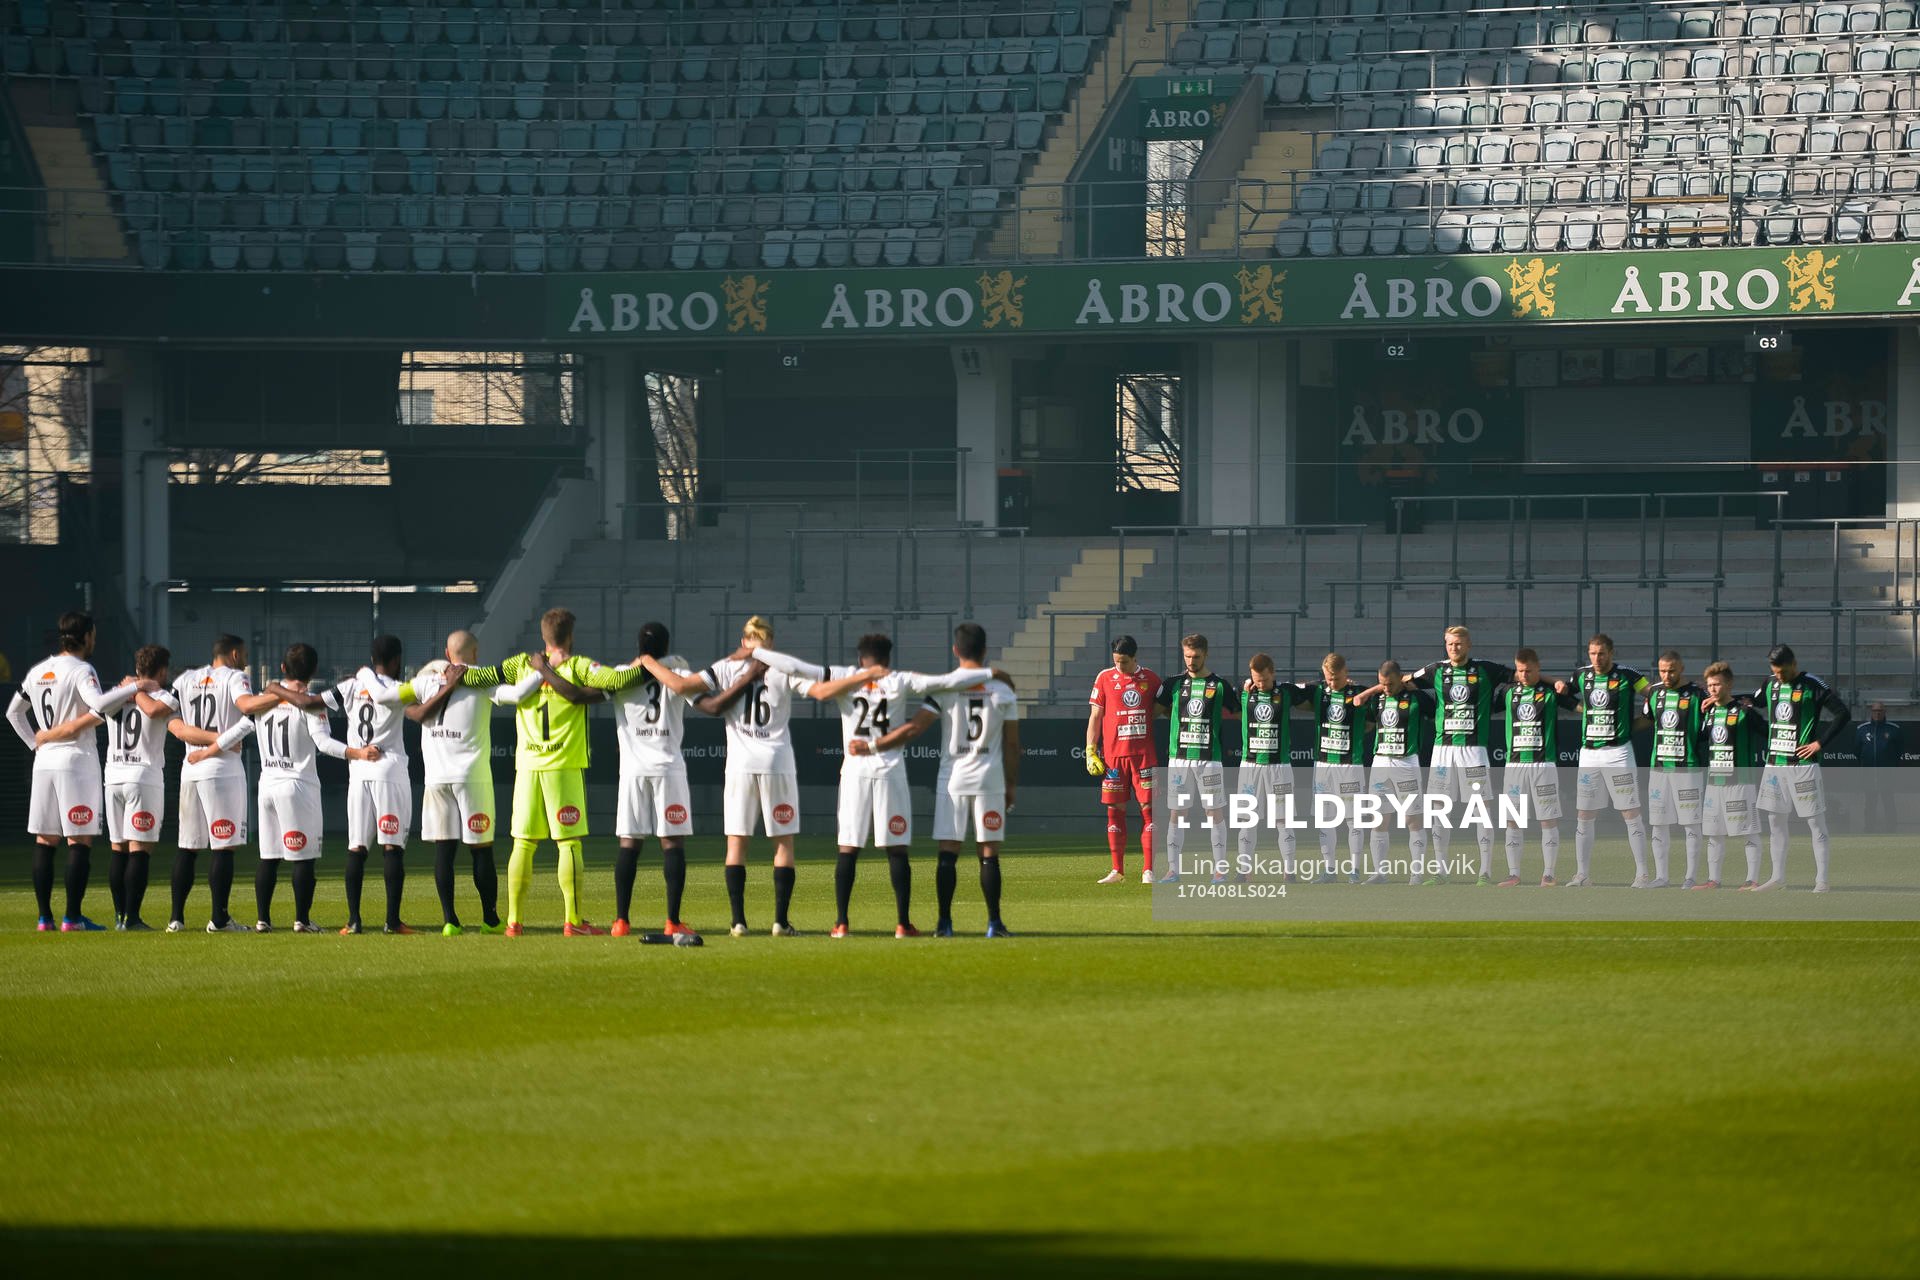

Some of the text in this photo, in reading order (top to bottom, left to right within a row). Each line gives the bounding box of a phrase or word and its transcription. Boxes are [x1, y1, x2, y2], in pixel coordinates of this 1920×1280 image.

[1145, 108, 1211, 128] ÅBRO
[568, 287, 718, 332] ÅBRO
[822, 284, 973, 329] ÅBRO
[1075, 279, 1232, 324] ÅBRO
[1341, 273, 1501, 318] ÅBRO
[1611, 266, 1779, 313] ÅBRO
[783, 356, 798, 366] G1
[1387, 346, 1404, 356] G2
[1759, 337, 1777, 349] G3
[1341, 404, 1484, 445] ÅBRO
[1780, 395, 1887, 438] ÅBR
[41, 687, 55, 730] 6
[189, 693, 218, 733] 12
[537, 701, 551, 741] 1
[645, 682, 661, 724] 3
[743, 684, 771, 727] 16
[853, 697, 890, 737] 24
[966, 699, 984, 742] 5
[1128, 715, 1146, 725] RSM
[1593, 715, 1614, 725] RSM
[112, 708, 143, 752] 19
[264, 713, 291, 759] 11
[357, 703, 375, 745] 8
[1190, 723, 1210, 733] RSM
[1258, 729, 1278, 738] RSM
[1330, 729, 1349, 740] RSM
[1384, 733, 1404, 743] RSM
[1521, 727, 1541, 736] RSM
[1663, 736, 1684, 746] RSM
[1777, 730, 1797, 740] RSM
[911, 746, 943, 758] Ullev
[1714, 751, 1734, 761] RSM
[1823, 752, 1836, 760] Got
